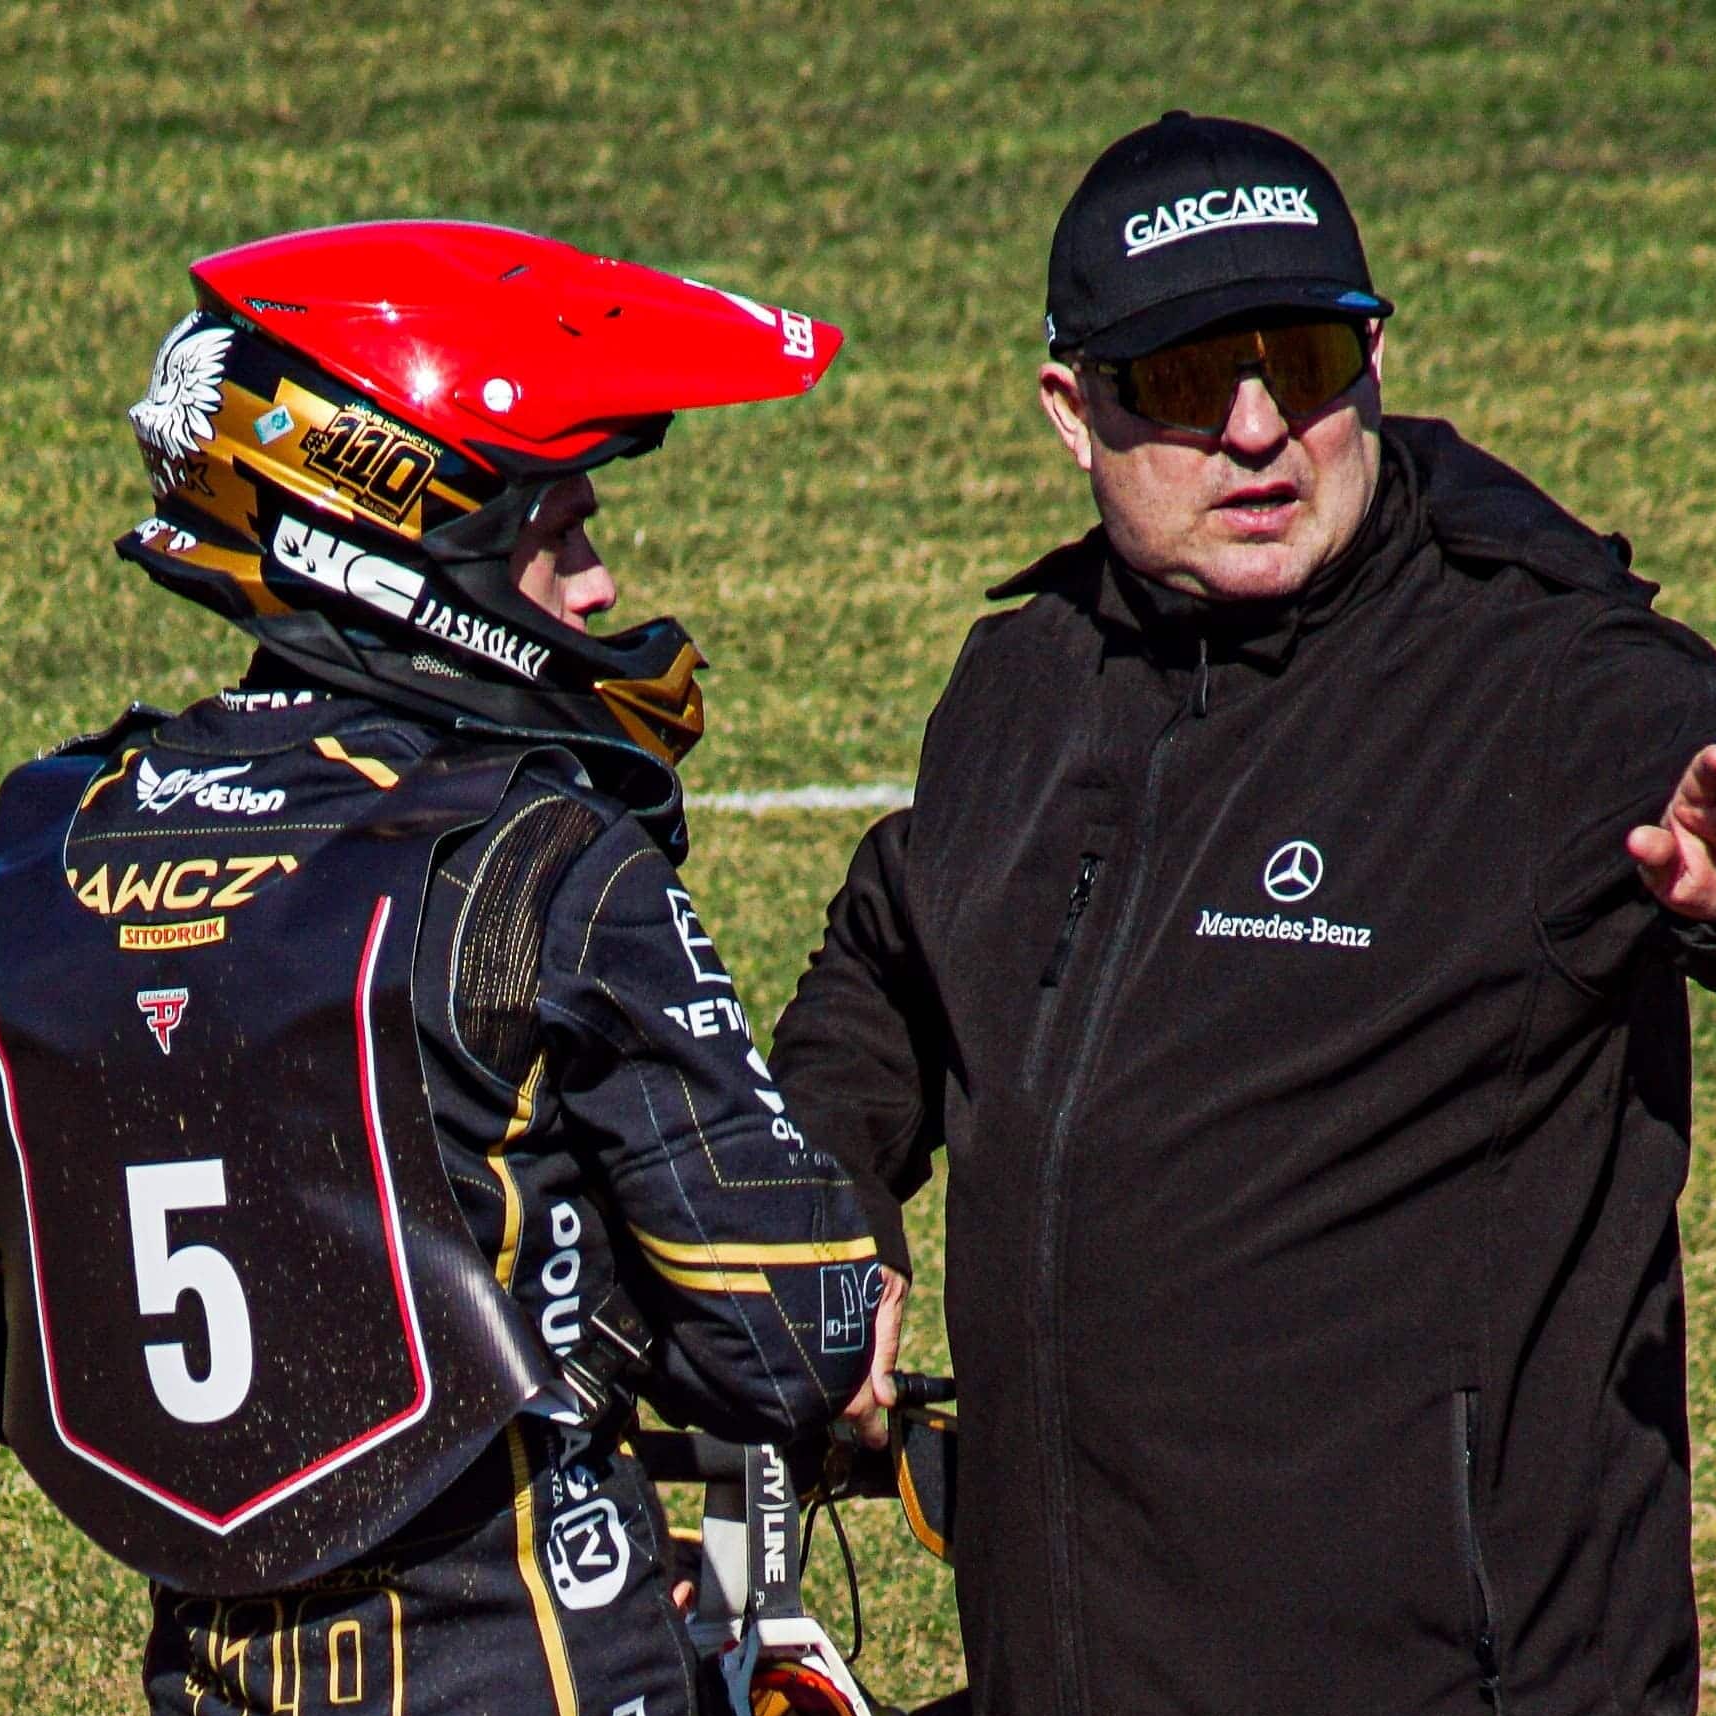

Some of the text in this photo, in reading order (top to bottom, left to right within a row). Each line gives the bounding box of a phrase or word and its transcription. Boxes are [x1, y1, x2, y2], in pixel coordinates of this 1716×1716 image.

[1124, 186, 1319, 248] GARCAREK
[67, 855, 298, 914] AWCZ
[123, 919, 221, 946] SITODRUK
[1195, 910, 1372, 948] Mercedes-Benz
[126, 1158, 255, 1423] 5
